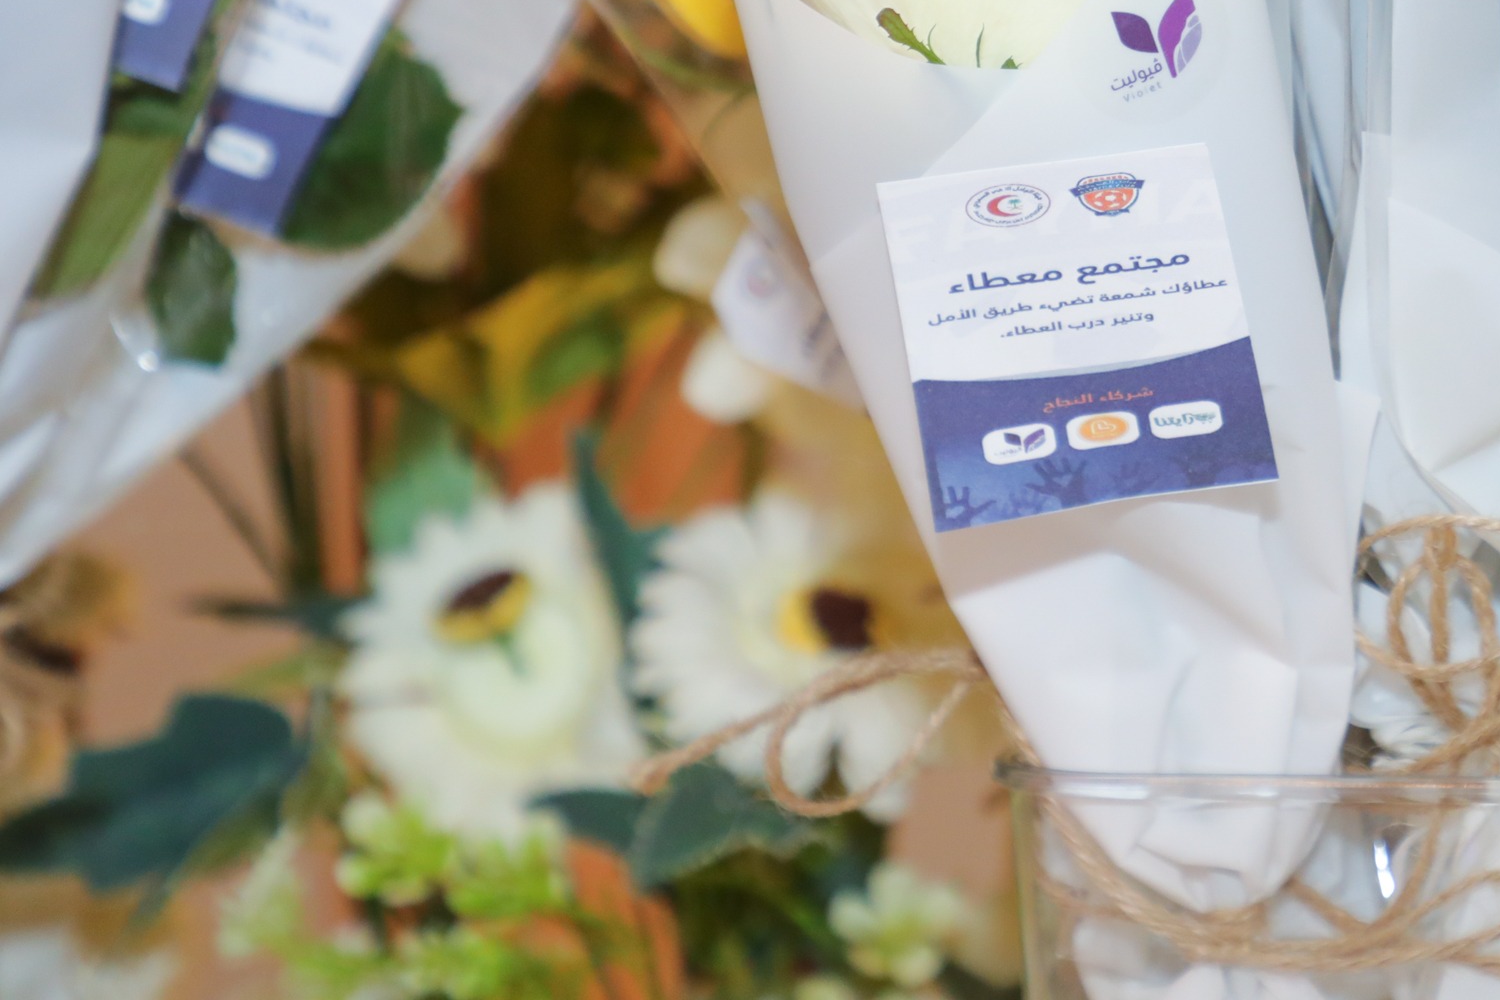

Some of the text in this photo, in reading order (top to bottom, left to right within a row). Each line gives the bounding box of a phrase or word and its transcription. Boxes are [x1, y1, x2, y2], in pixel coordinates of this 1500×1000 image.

[949, 253, 1190, 294] مجتمع معطاء
[928, 278, 1228, 327] عطاؤك شمعة تضيء طريق الأمل
[1067, 315, 1105, 330] درب
[1111, 311, 1155, 327] وتنير
